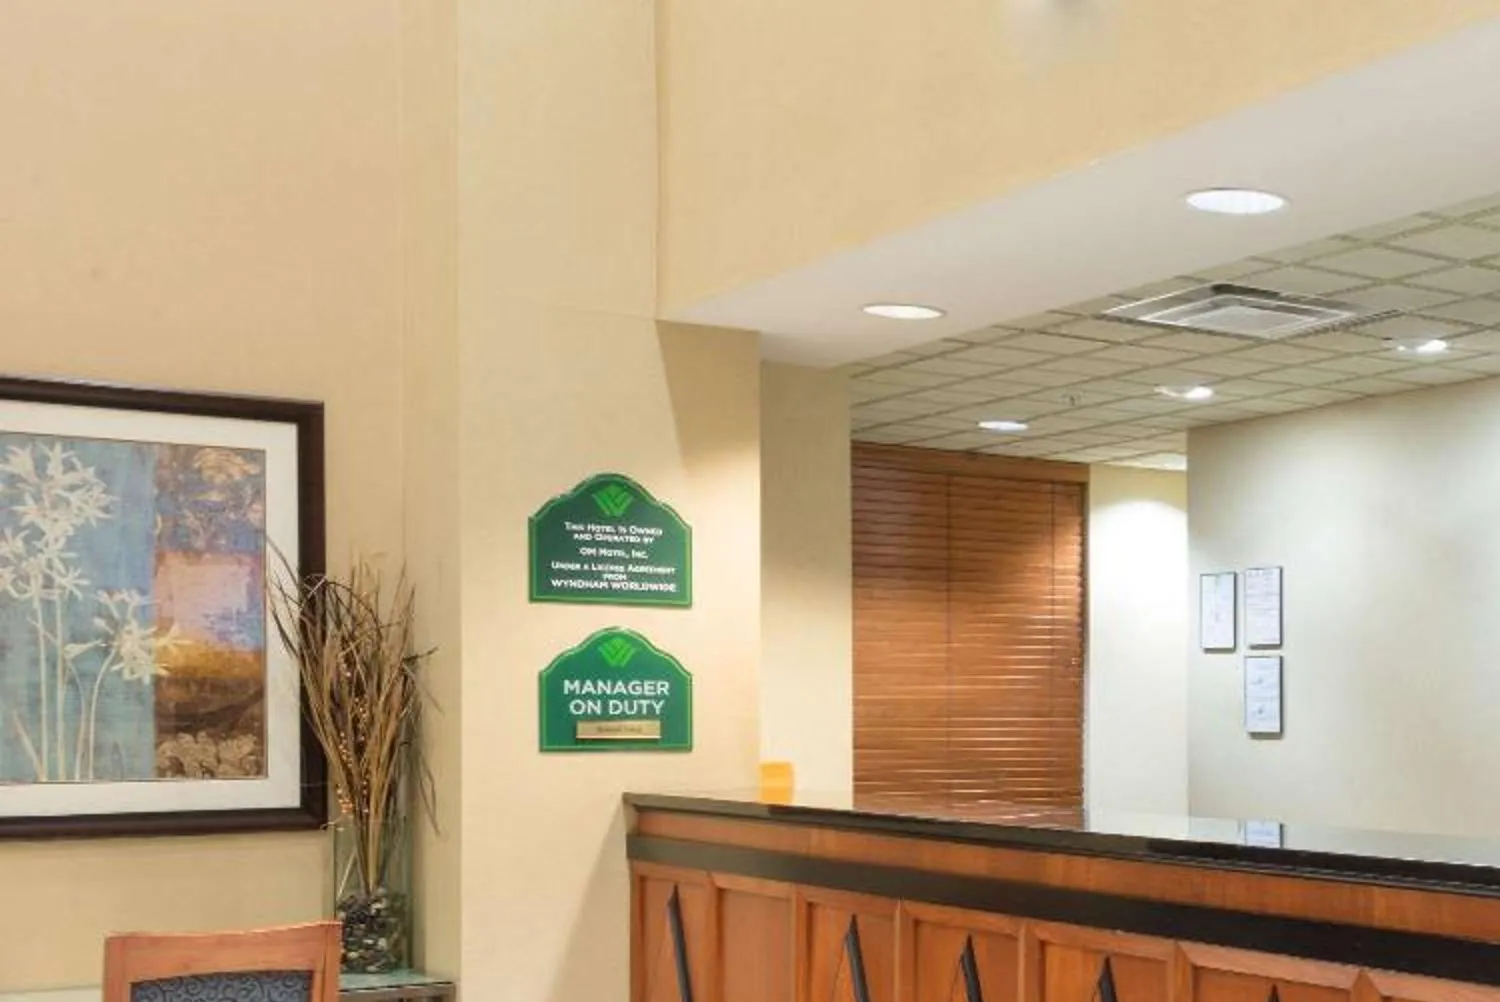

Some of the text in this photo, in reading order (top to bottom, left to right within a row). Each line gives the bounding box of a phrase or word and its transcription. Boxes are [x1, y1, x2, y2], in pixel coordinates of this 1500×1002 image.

[551, 579, 677, 592] WYNDHAM WORLDWIDE
[563, 679, 670, 696] MANAGER
[569, 699, 665, 715] ON DUTY
